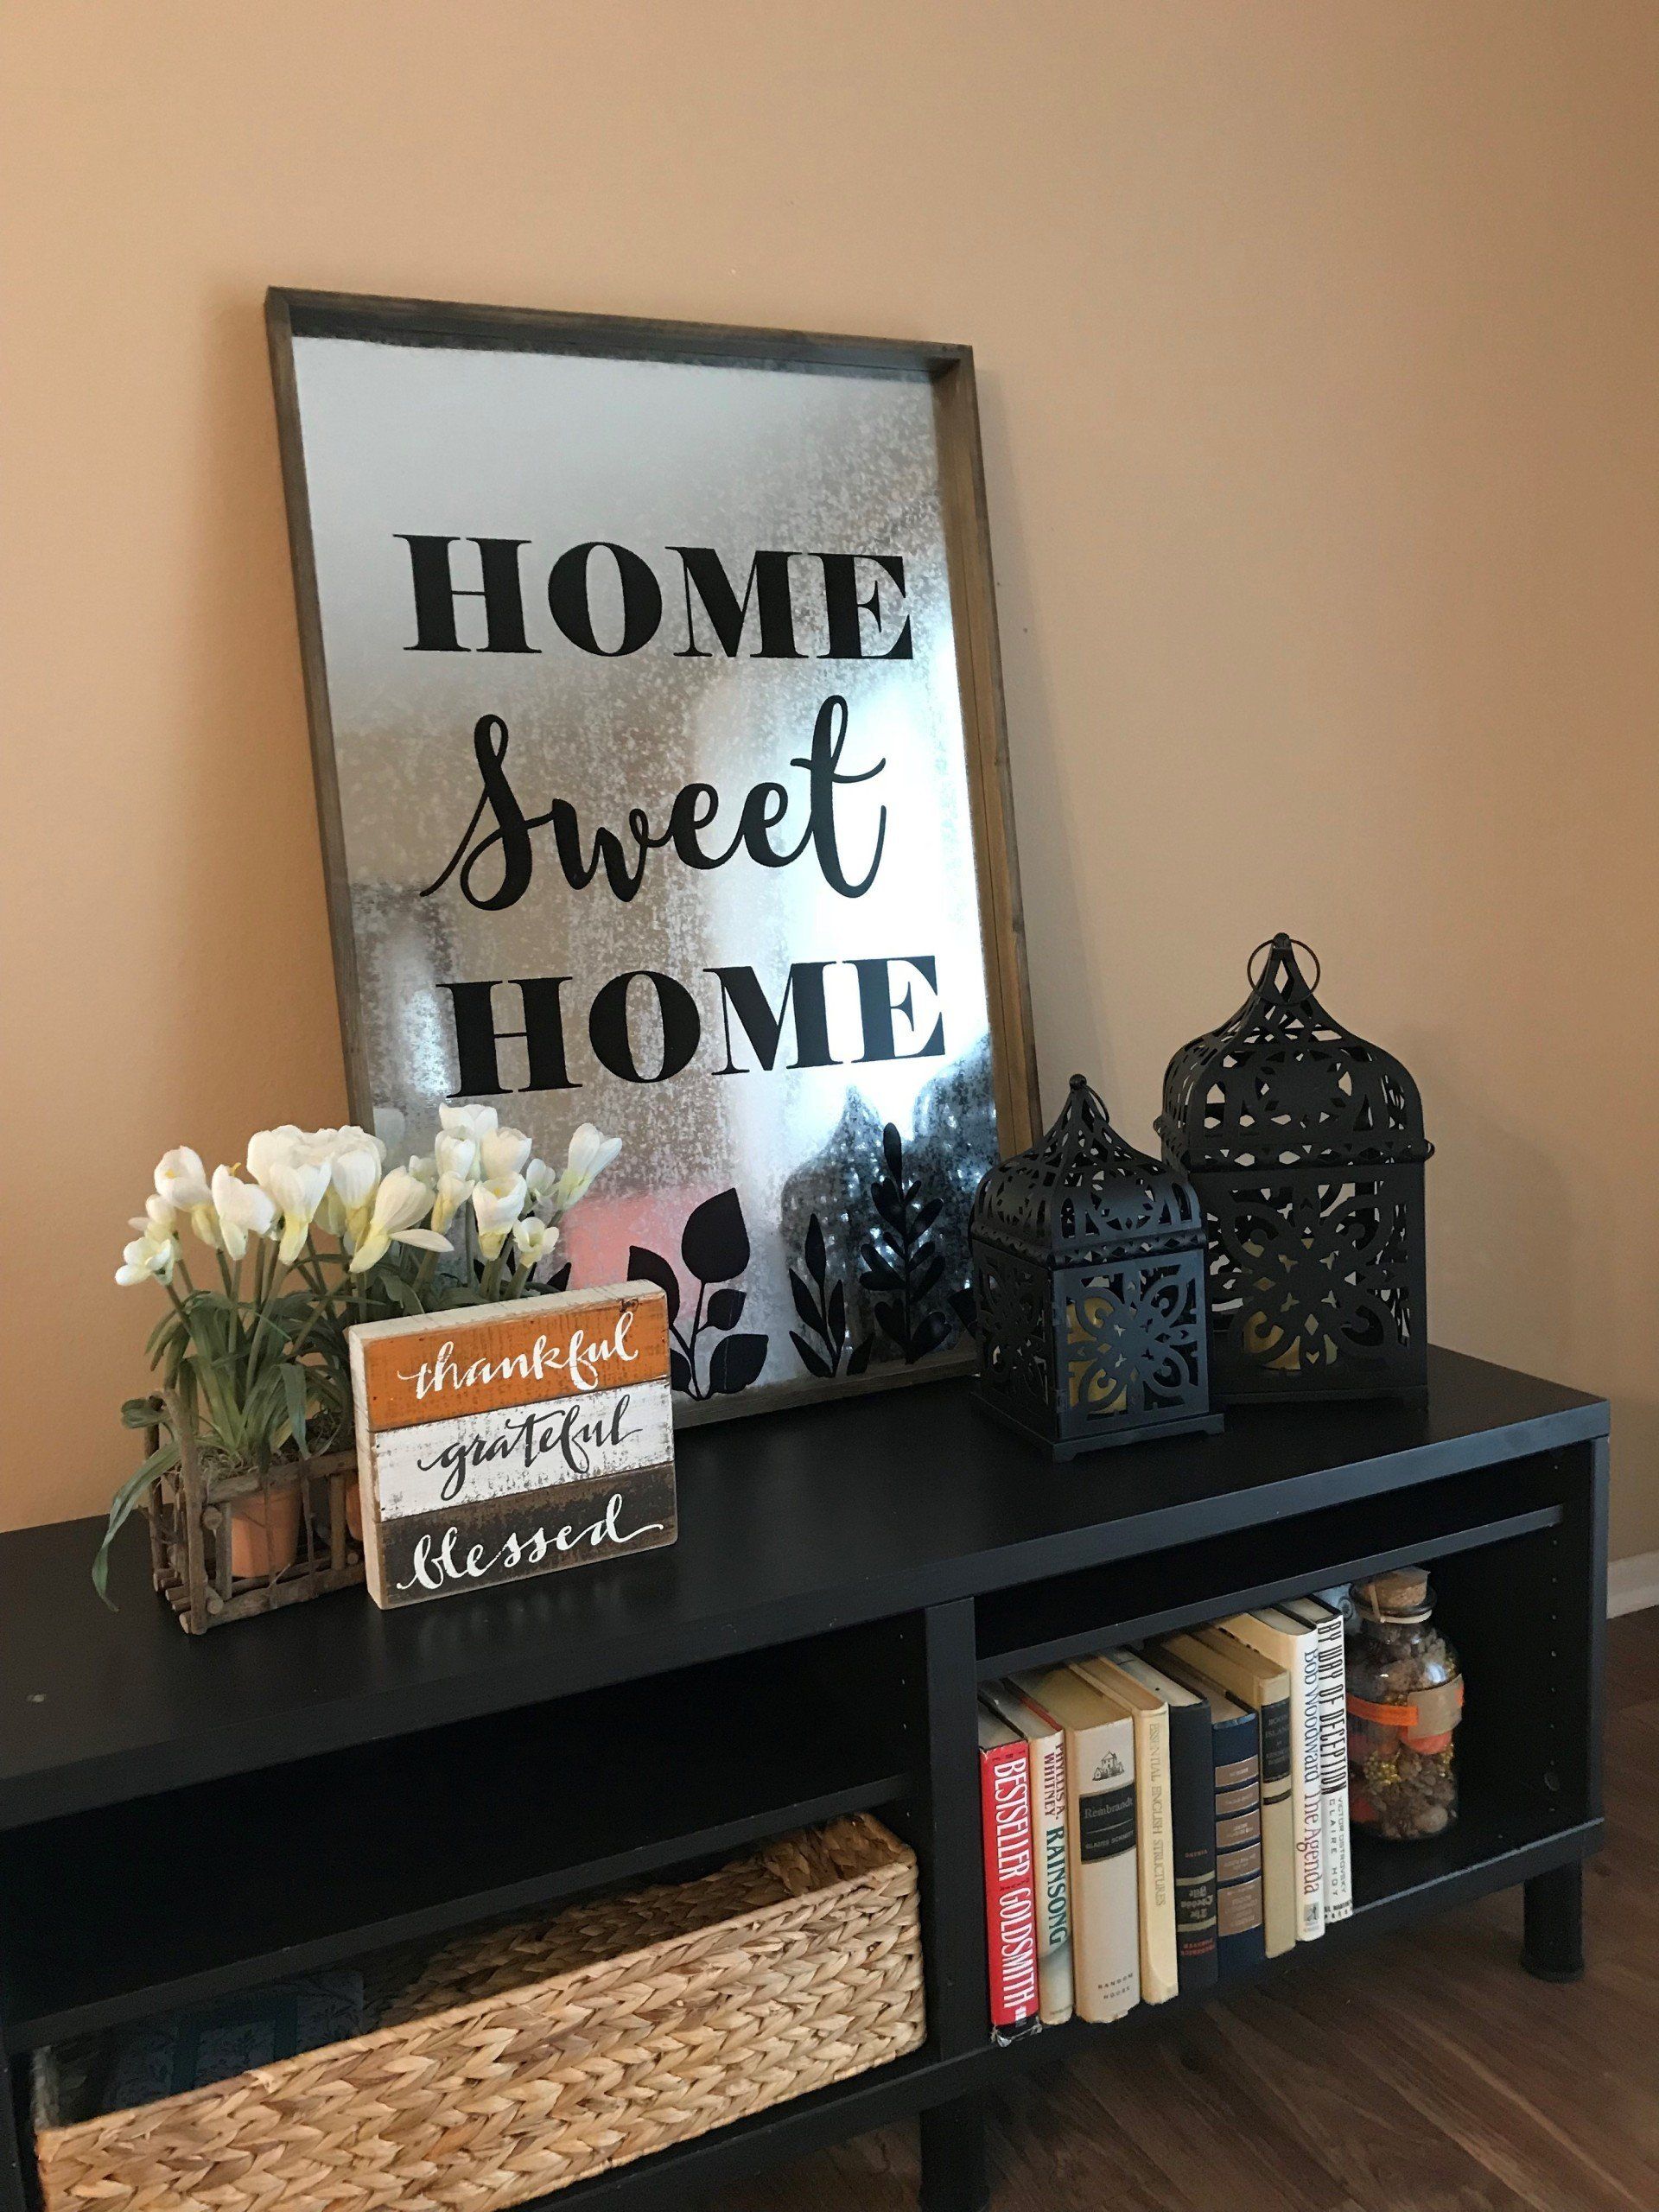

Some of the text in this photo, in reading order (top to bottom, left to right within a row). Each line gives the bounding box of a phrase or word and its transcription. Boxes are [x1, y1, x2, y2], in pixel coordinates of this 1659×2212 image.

[393, 533, 913, 659] HOME
[420, 695, 887, 911] Sweet
[436, 955, 945, 1098] HOME
[397, 1311, 639, 1400] thankful
[417, 1395, 643, 1501] grateful
[397, 1494, 664, 1590] blessed
[1318, 1620, 1346, 1796] BY WAY OF DECEPTION
[994, 1758, 1030, 1883] BESTSELLER
[1044, 1751, 1056, 1817] WHITNEY
[1055, 1742, 1065, 1802] PHYLLIS
[1084, 1796, 1134, 1820] Rembrandt
[1149, 1722, 1166, 1907] ESSENTIAL ENGLISH STRUCTURES
[1296, 1649, 1322, 1895] Bob Woodward The Agenda
[1329, 1799, 1338, 1853] CLAIRE
[1046, 1825, 1068, 1946] RAINSONG
[1000, 1887, 1035, 2008] GOLDSMITH
